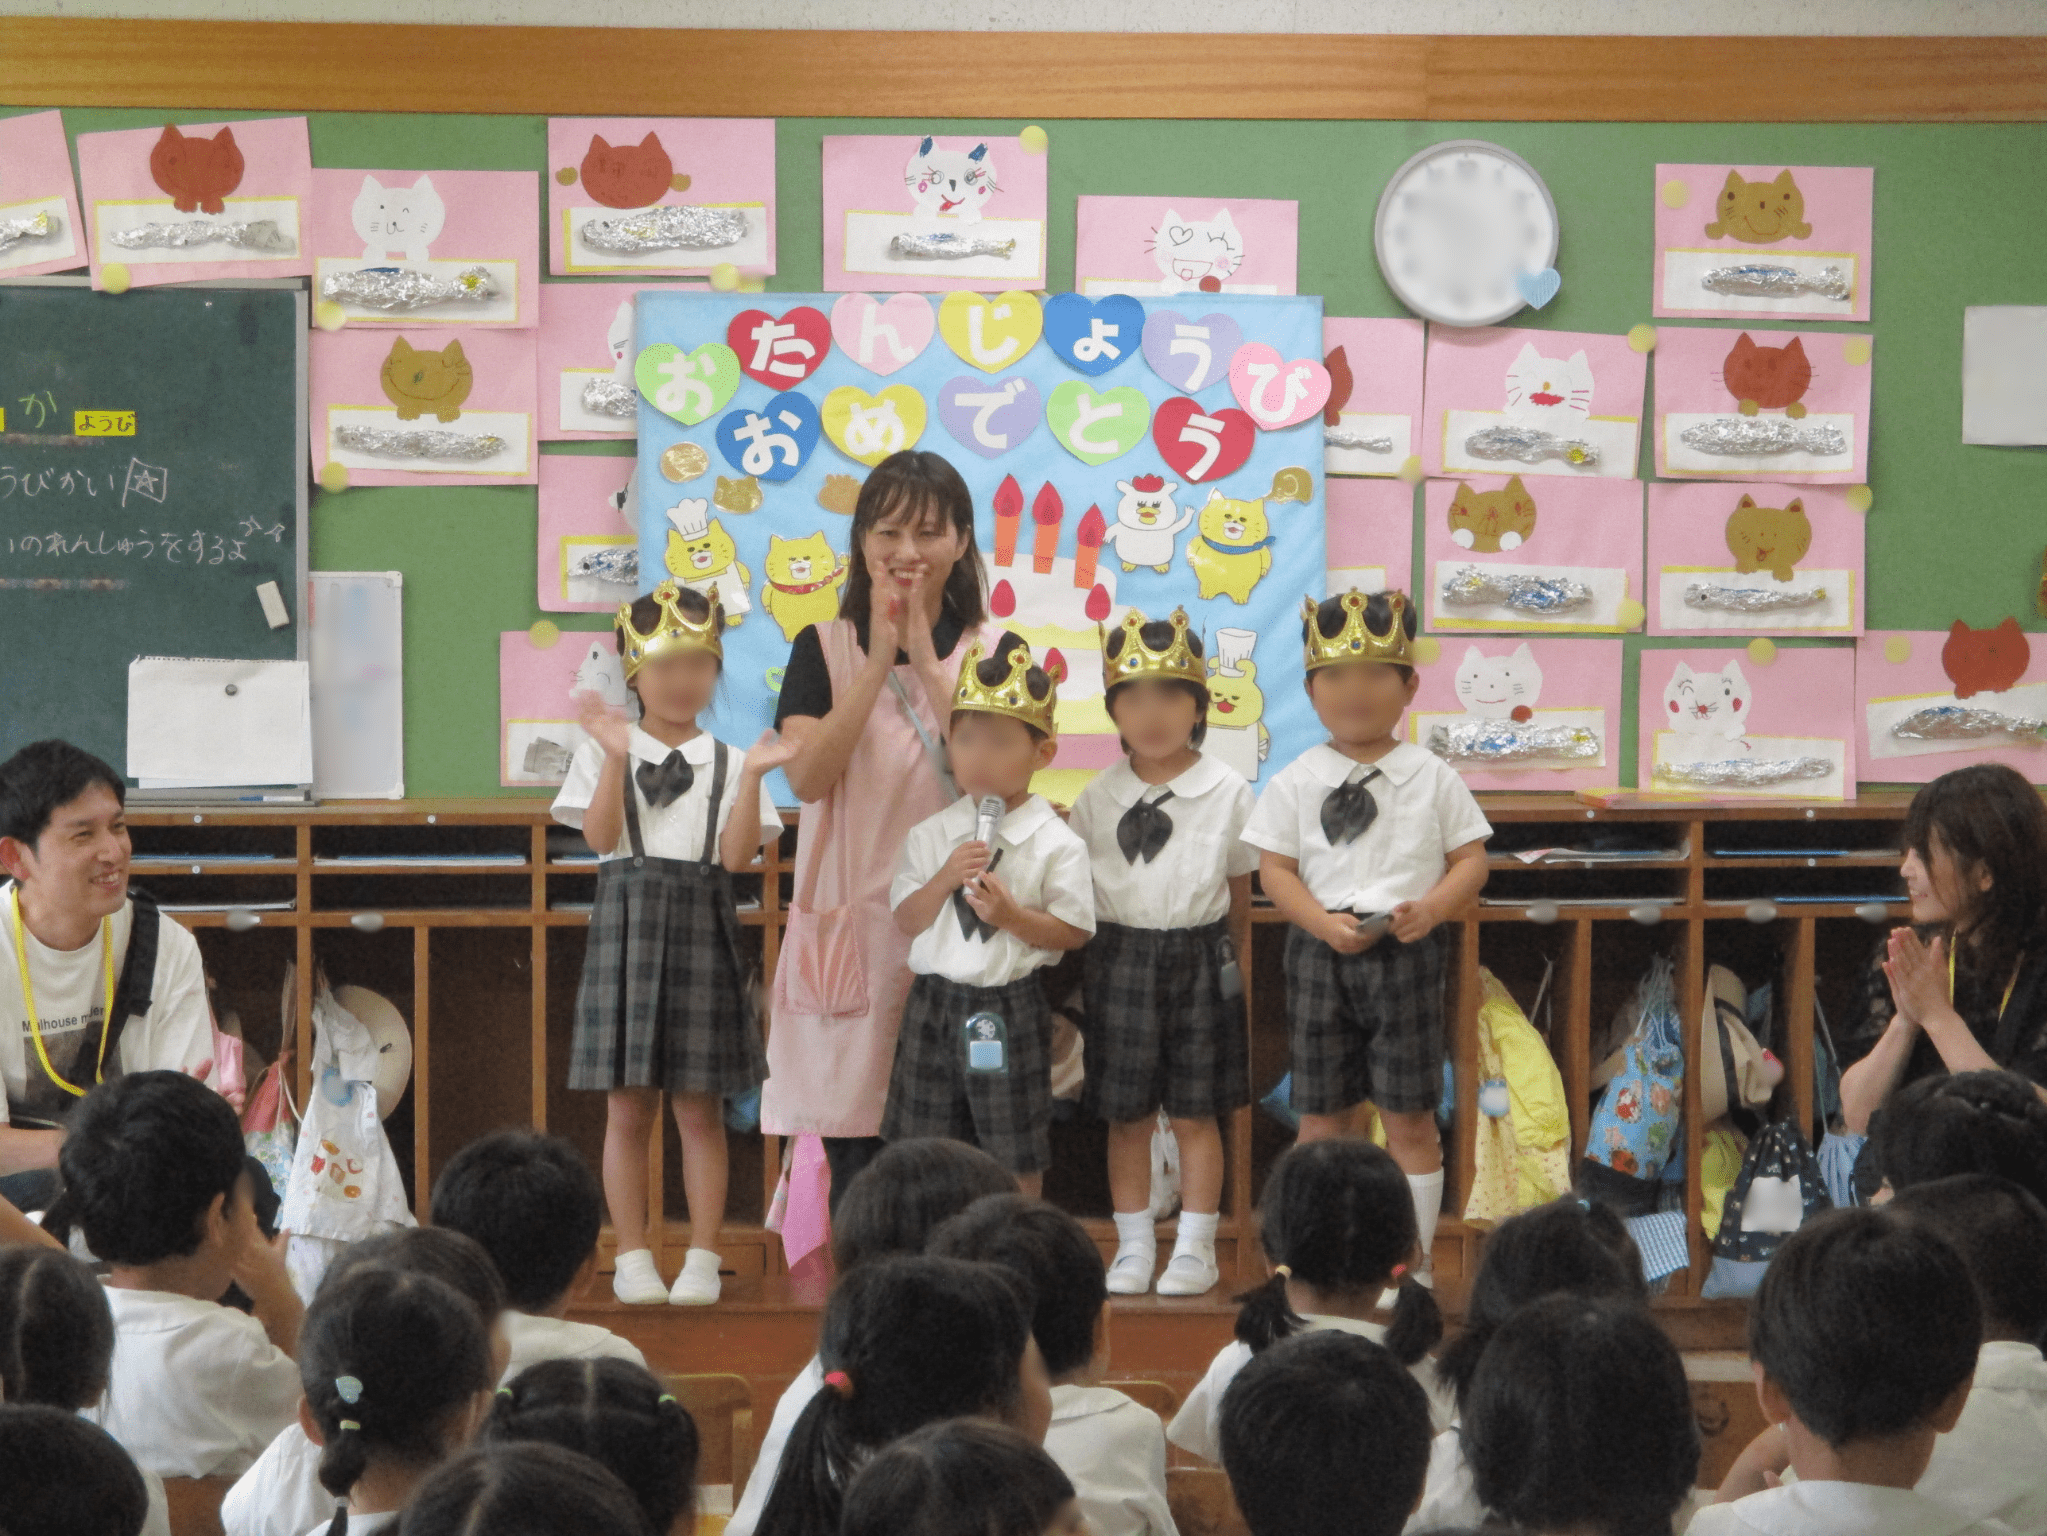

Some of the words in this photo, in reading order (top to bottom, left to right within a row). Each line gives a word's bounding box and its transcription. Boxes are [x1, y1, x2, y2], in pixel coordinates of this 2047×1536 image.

[18, 391, 57, 428] か
[78, 415, 137, 432] ようび
[655, 304, 1312, 422] おたんじょうび
[733, 379, 1231, 480] おめでとう
